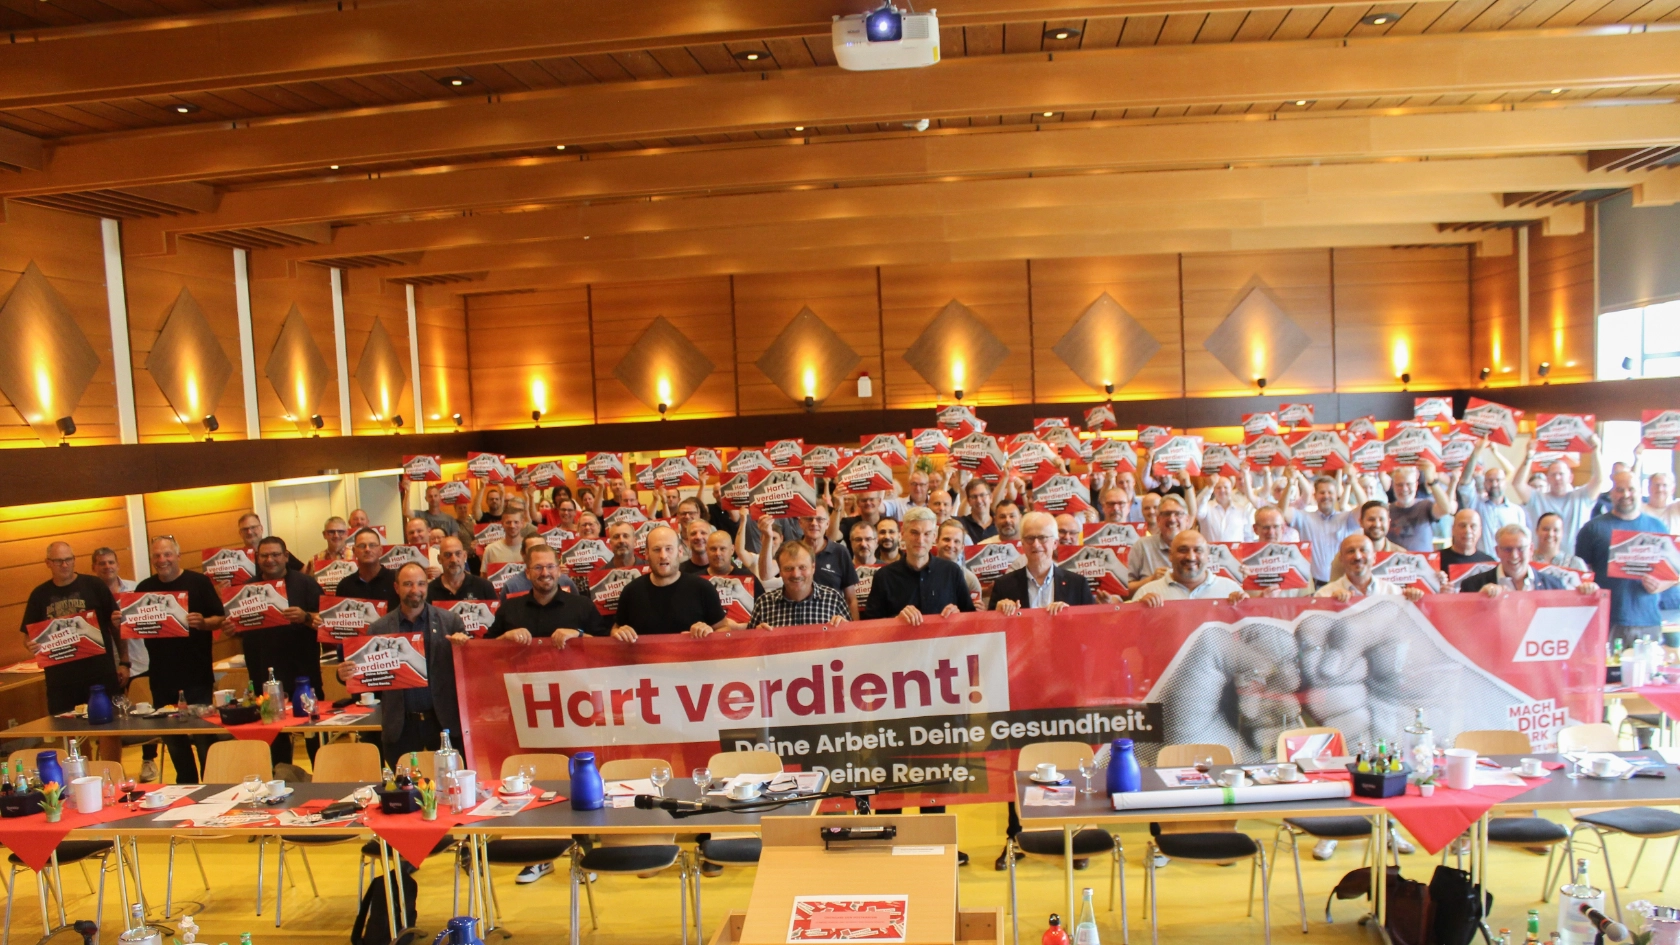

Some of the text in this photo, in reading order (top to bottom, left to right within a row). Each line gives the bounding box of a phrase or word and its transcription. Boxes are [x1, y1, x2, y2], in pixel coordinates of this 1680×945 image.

[766, 484, 784, 493] Hart
[756, 491, 792, 503] verdient!
[983, 555, 999, 564] Hart
[974, 562, 1008, 572] verdient!
[608, 581, 624, 590] Hart
[241, 597, 258, 606] Hart
[128, 613, 166, 622] verdient!
[1526, 640, 1570, 657] DGB
[367, 651, 388, 662] Hart
[522, 654, 982, 728] Hart verdient!
[1509, 702, 1551, 717] MACH
[1518, 712, 1565, 732] DICH
[735, 709, 1152, 756] Deine Arbeit. Deine Gesundheit.
[893, 764, 975, 783] Rente.
